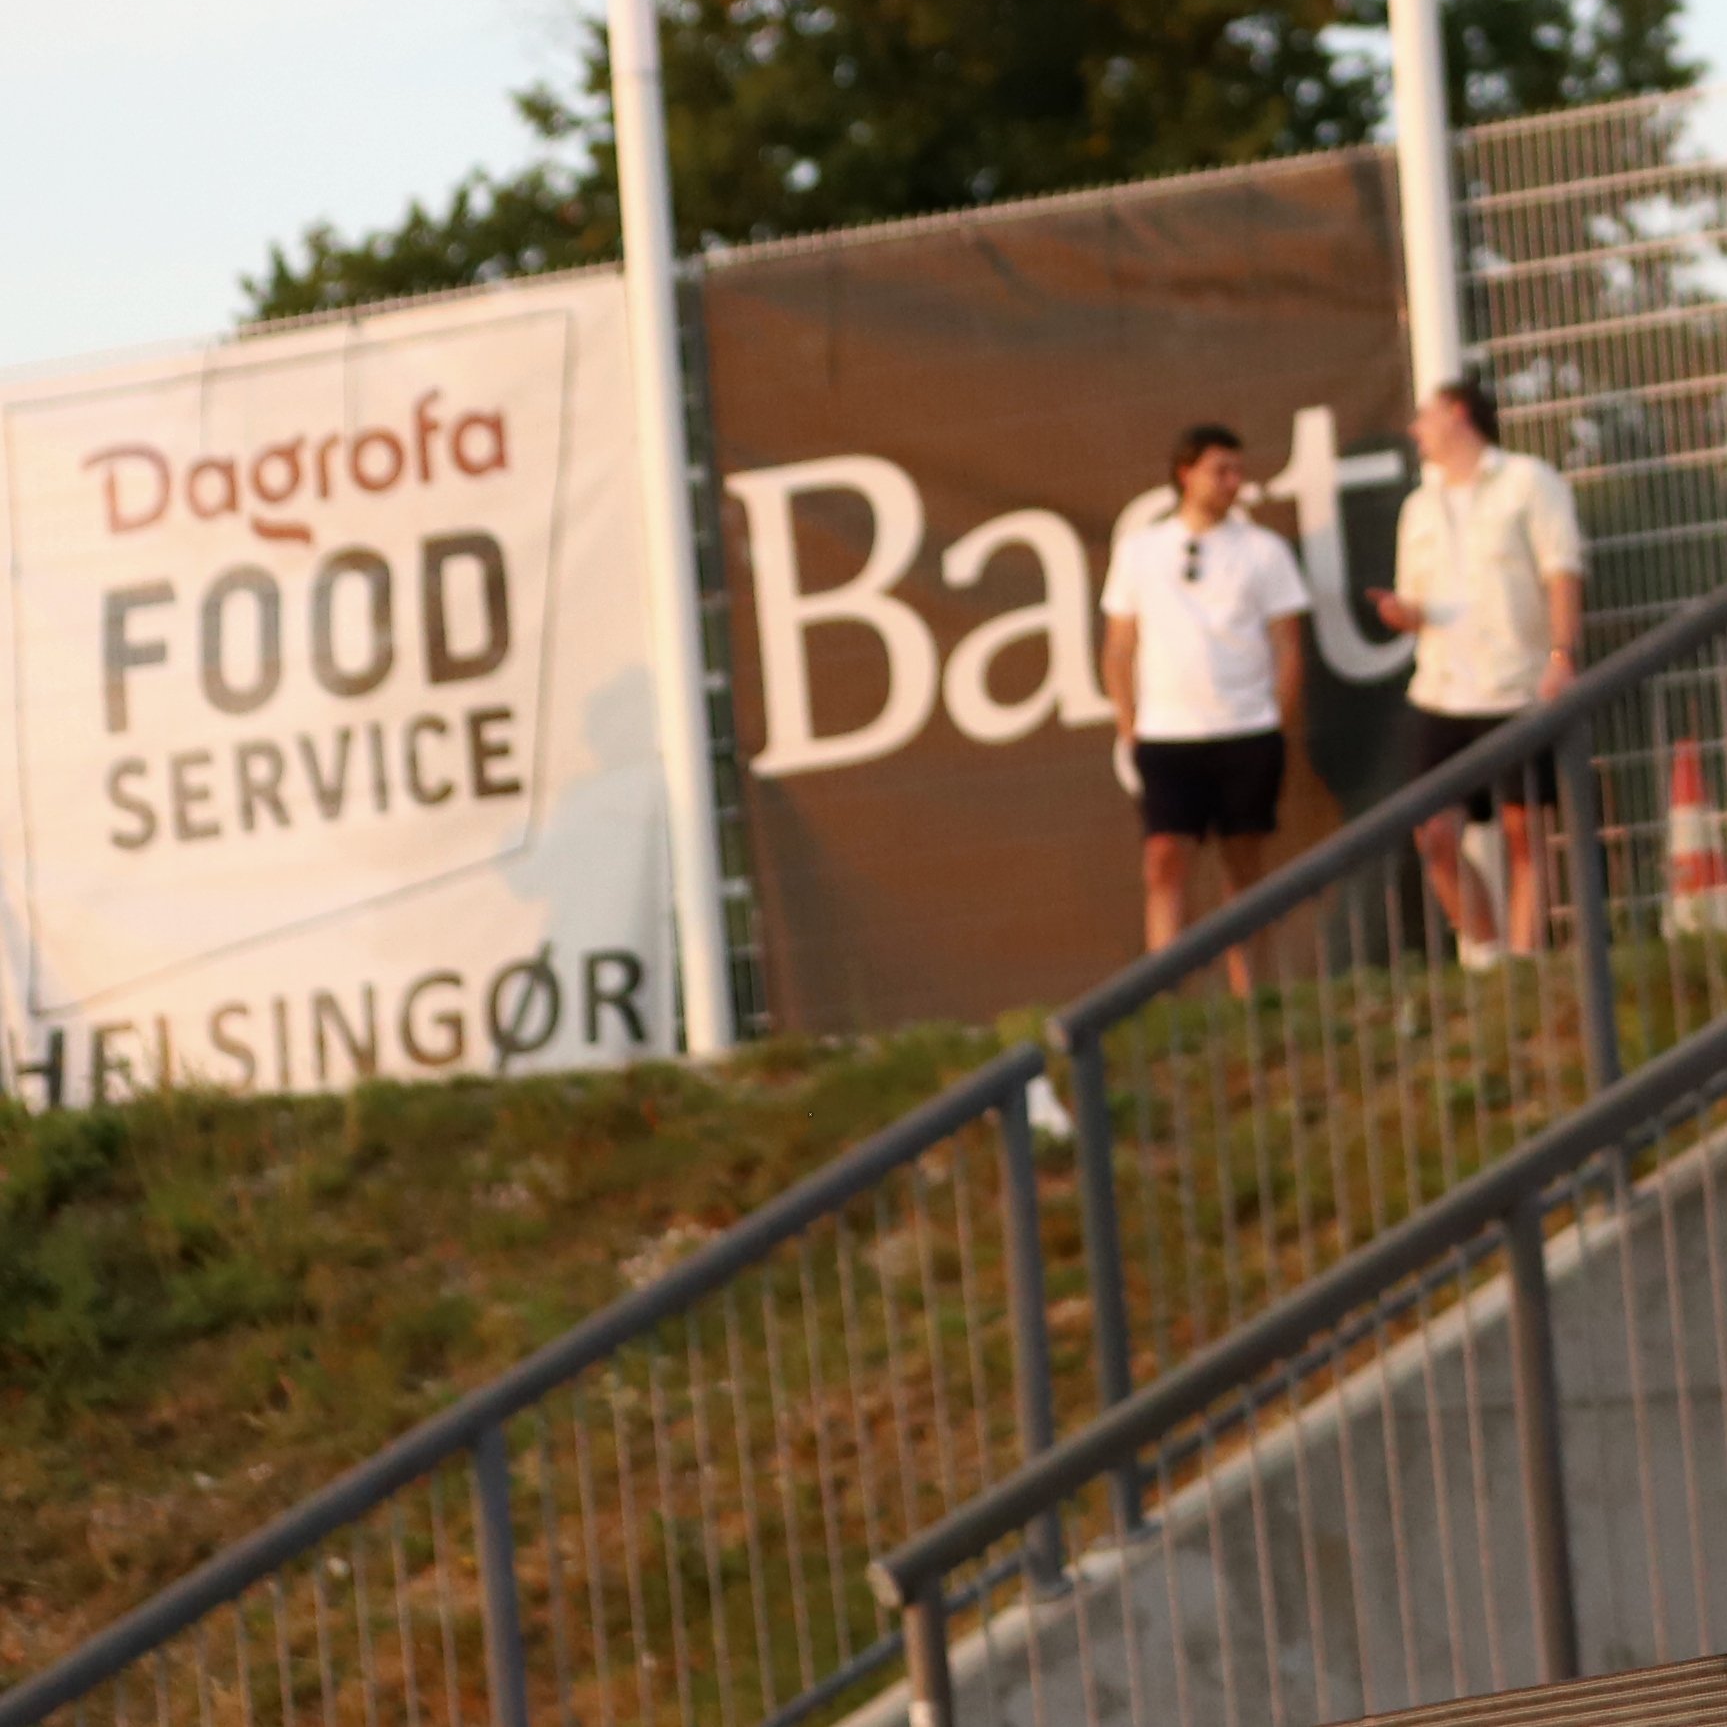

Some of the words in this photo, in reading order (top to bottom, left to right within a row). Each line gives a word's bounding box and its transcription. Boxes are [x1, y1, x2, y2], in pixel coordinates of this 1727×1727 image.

[84, 389, 506, 543] Dagrofa
[104, 529, 511, 735] FOOD
[726, 405, 1416, 795] Bat
[106, 705, 523, 850] SERVICE
